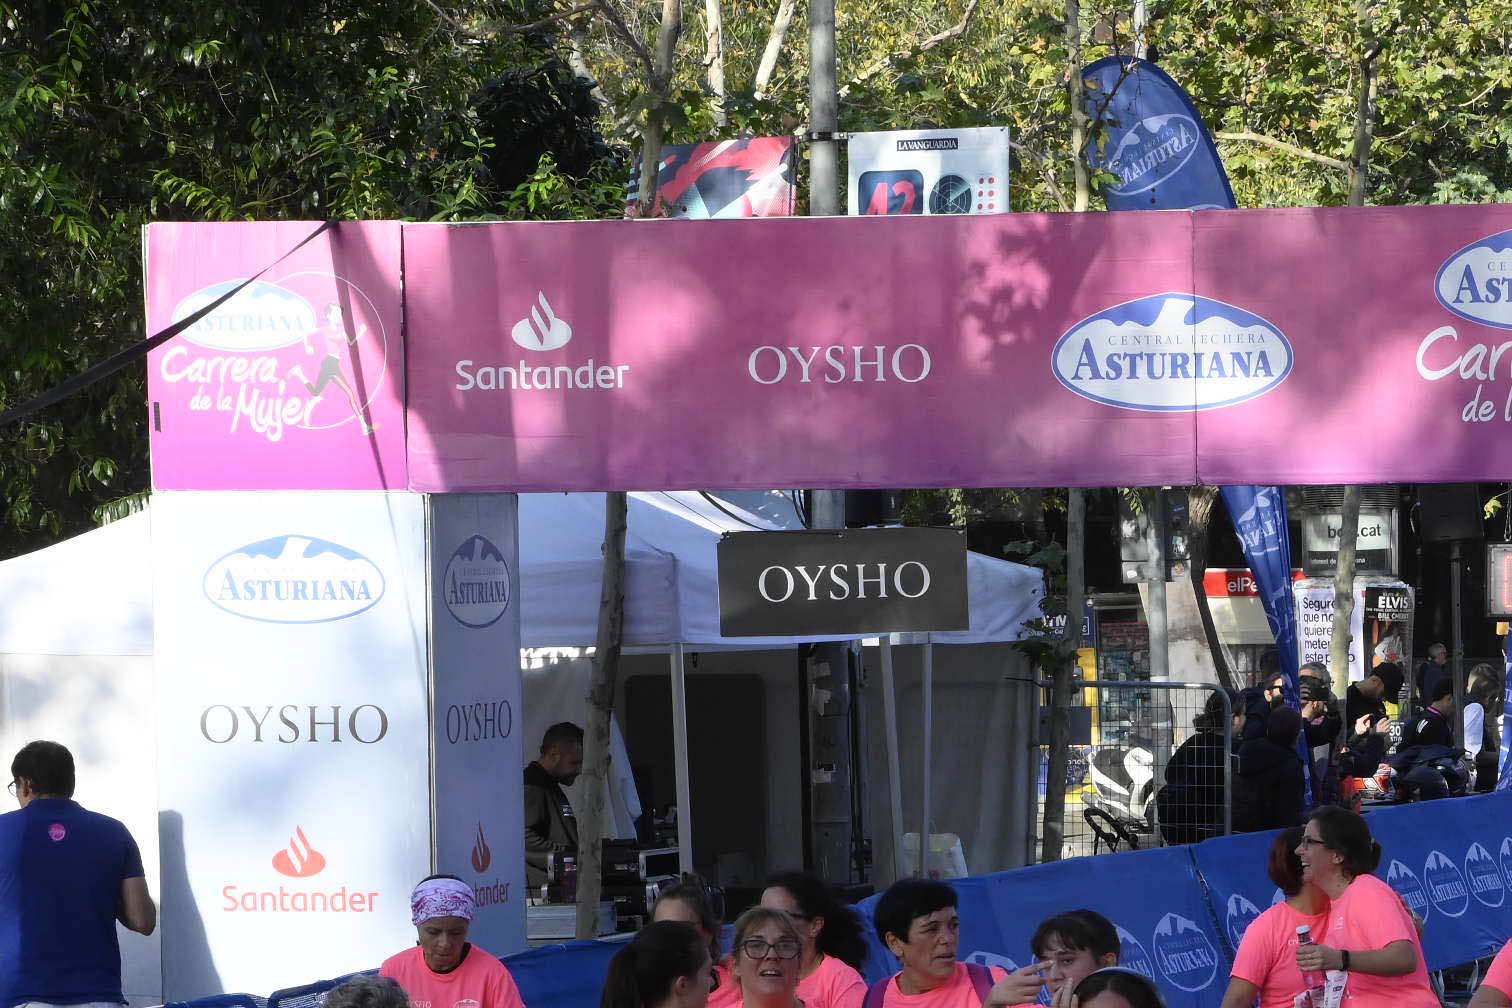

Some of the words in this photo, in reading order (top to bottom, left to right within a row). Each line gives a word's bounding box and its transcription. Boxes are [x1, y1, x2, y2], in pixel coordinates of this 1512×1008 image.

[1107, 334, 1183, 346] CENTRAL
[160, 345, 280, 384] Carrera
[455, 357, 630, 394] Santander
[747, 344, 932, 385] OYSHO
[1071, 337, 1274, 382] ASTURIANA
[190, 384, 212, 412] de
[217, 381, 233, 412] la
[230, 379, 323, 442] Mujer
[1462, 388, 1497, 423] de
[218, 568, 373, 601] ASTURIANA
[449, 569, 507, 605] ASTURIANA
[757, 561, 931, 604] OYSHO
[1303, 597, 1335, 611] Segur
[200, 703, 389, 744] OYSHO
[446, 700, 513, 744] OYSHO
[222, 885, 379, 913] Santander
[475, 881, 510, 908] tander
